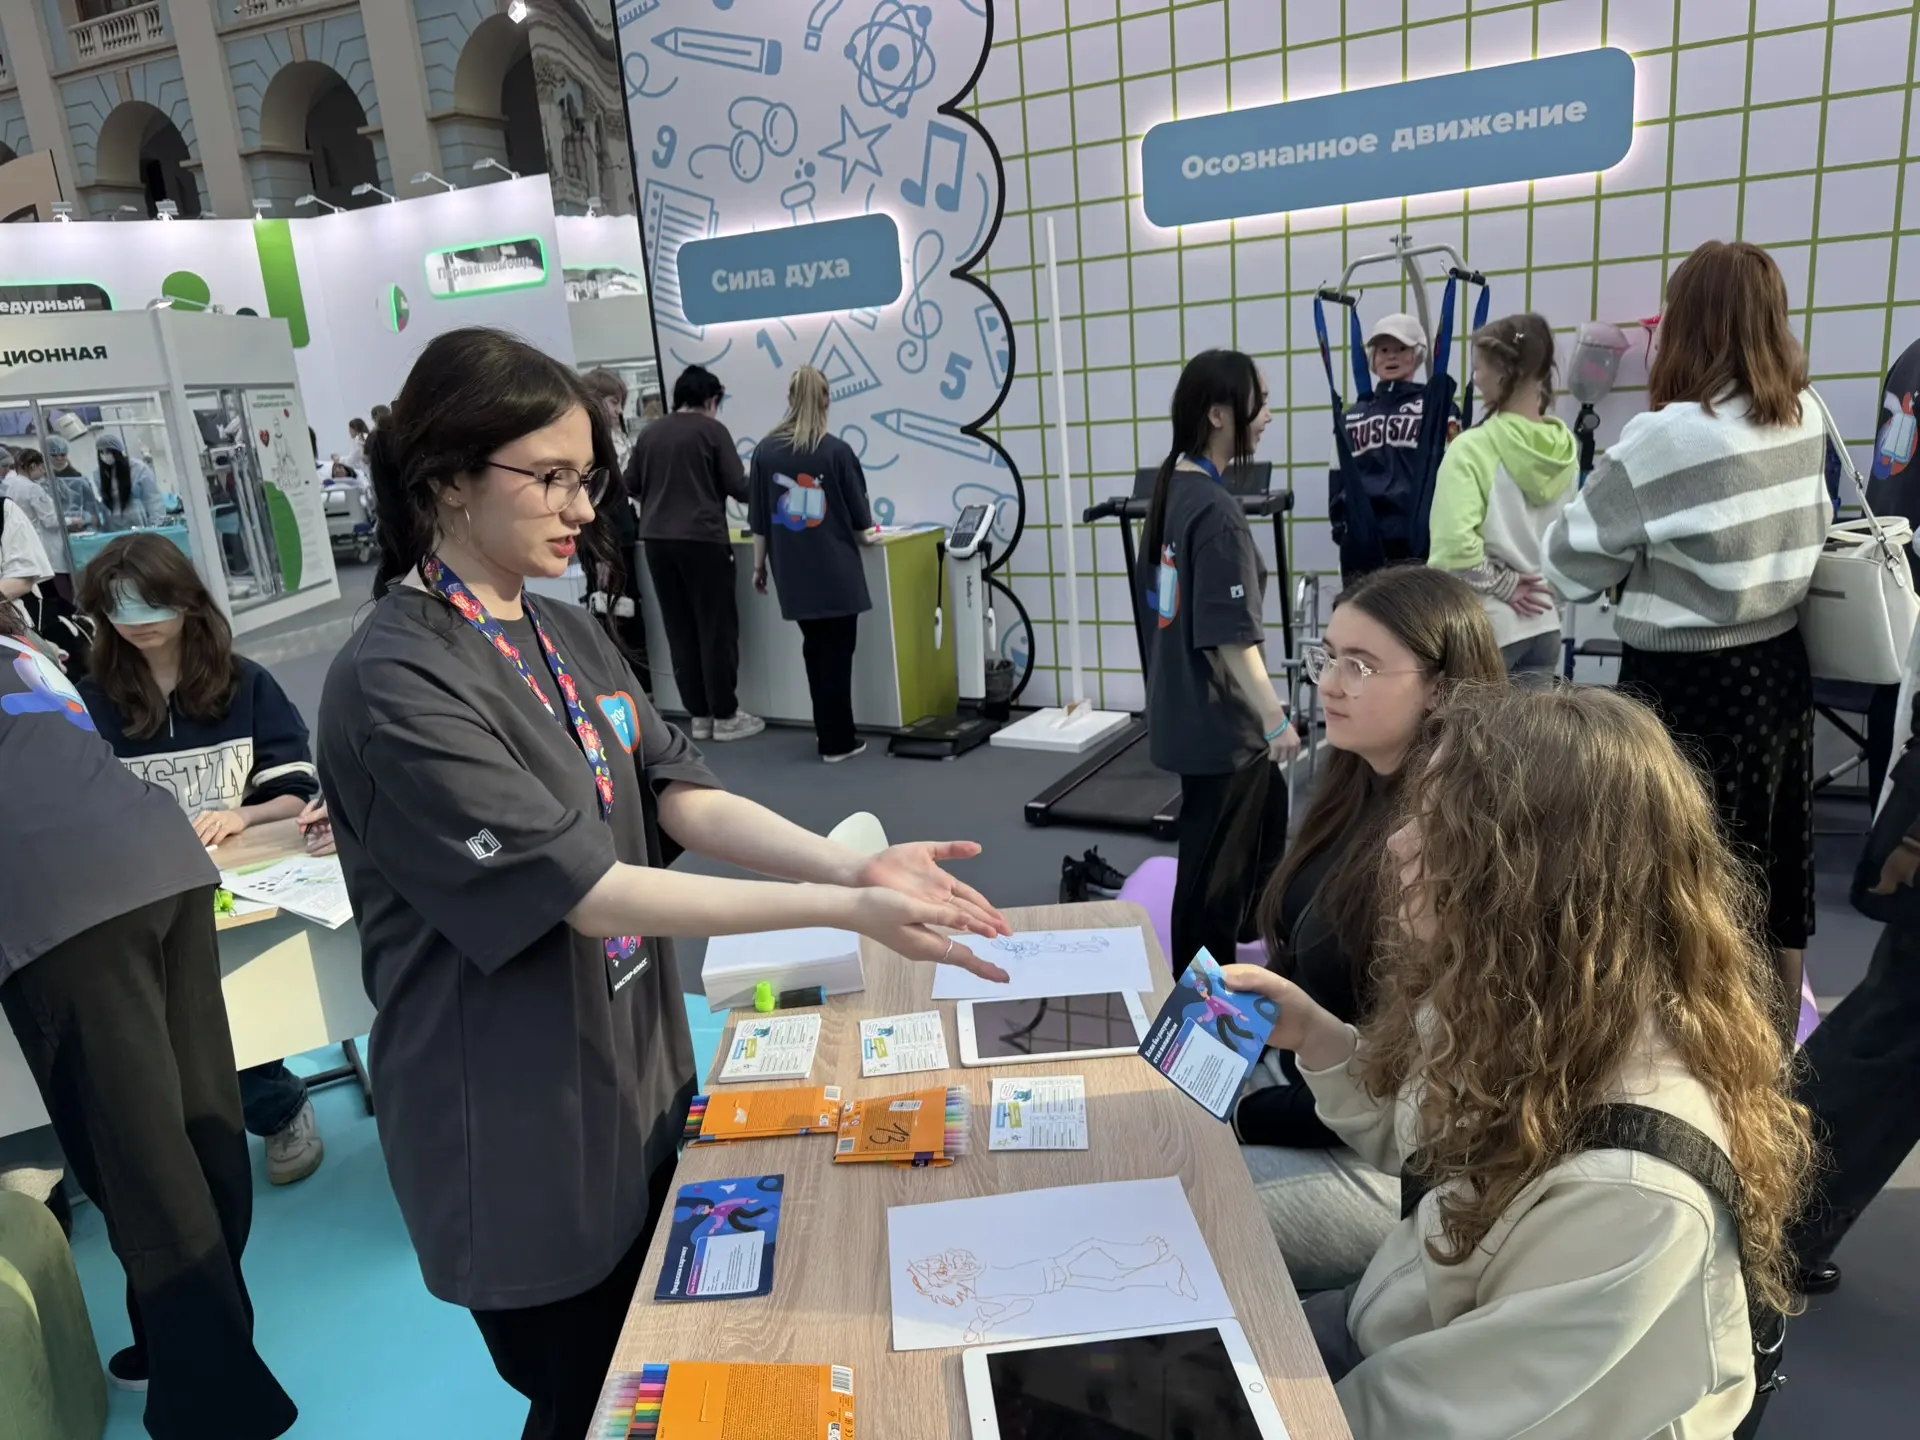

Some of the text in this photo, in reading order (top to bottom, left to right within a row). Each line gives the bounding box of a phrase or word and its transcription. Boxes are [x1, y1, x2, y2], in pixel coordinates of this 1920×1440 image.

[1181, 99, 1587, 180] Осознанное движение
[711, 257, 851, 293] Сила духа
[940, 351, 973, 400] 5
[1346, 415, 1422, 457] RUSSIA
[1145, 1043, 1156, 1057] Если
[1156, 1016, 1172, 1040] рисунок
[1160, 1023, 1178, 1052] волшебным
